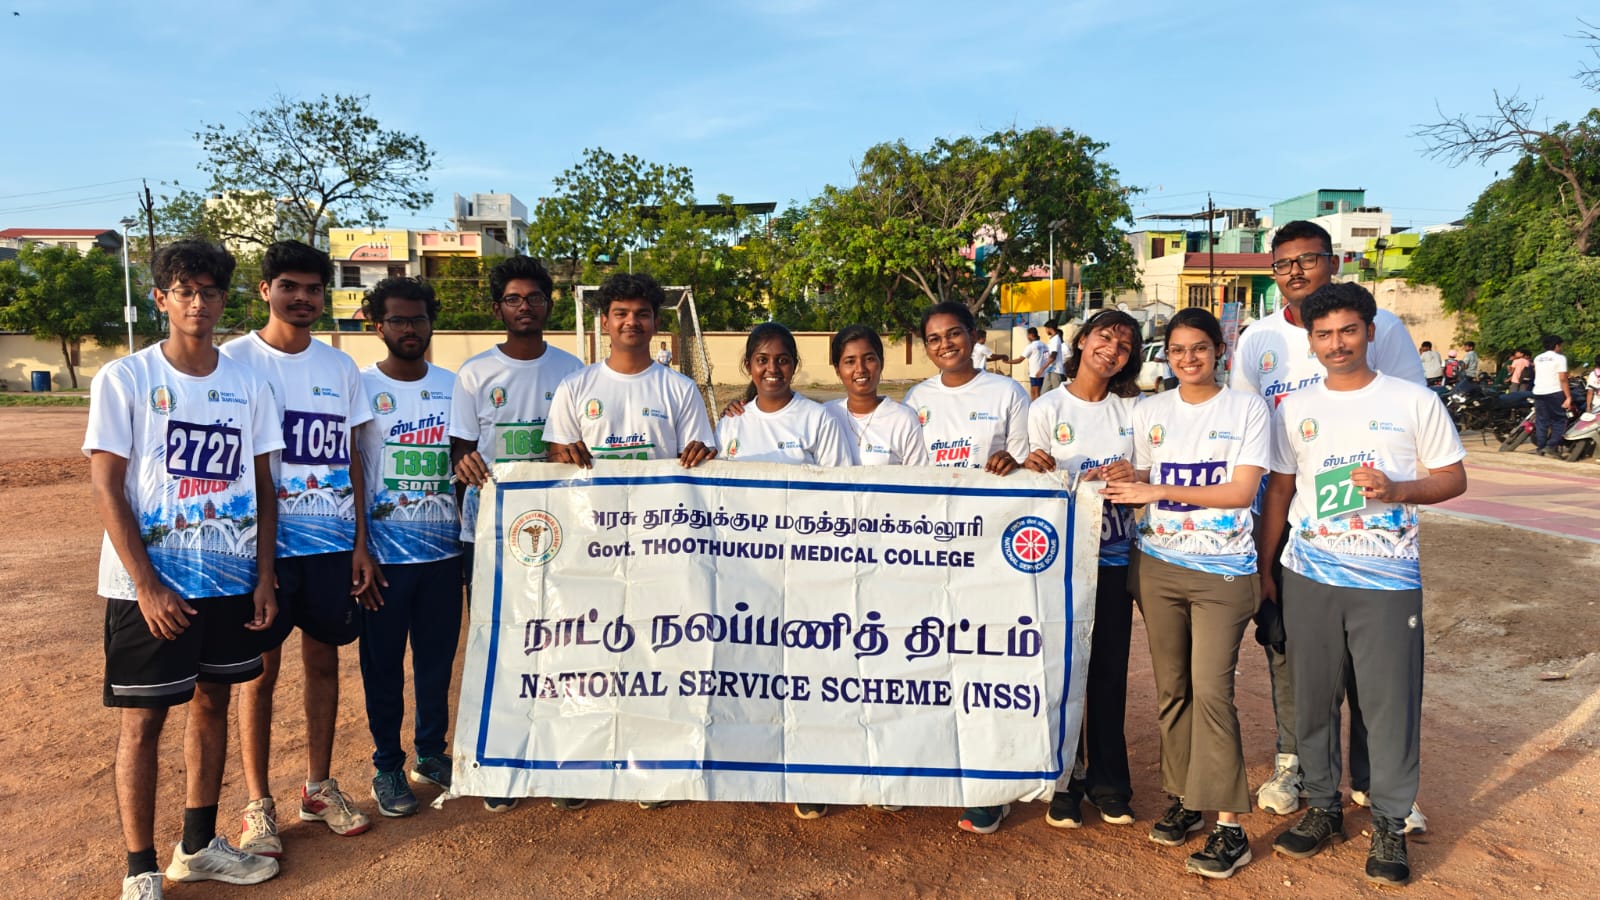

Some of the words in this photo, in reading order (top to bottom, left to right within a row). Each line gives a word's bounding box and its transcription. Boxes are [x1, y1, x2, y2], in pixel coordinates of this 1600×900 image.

[390, 411, 445, 436] ஸ்டார்ட்
[400, 425, 445, 445] RUN
[168, 428, 240, 475] 2727
[292, 418, 346, 459] 1057
[930, 436, 972, 450] ஸ்டார்ட்
[392, 450, 448, 476] 1339
[936, 447, 971, 462] RUN
[1323, 450, 1376, 467] ஸ்டார்ட்
[398, 481, 440, 491] SDAT
[643, 503, 768, 531] தூத்துக்குடி
[775, 511, 983, 542] மருத்துவக்கல்லூரி
[587, 541, 636, 558] Govt.
[642, 537, 784, 560] THOOTHUKUDI
[790, 544, 878, 563] MEDICAL
[884, 548, 975, 567] COLLEGE
[524, 608, 636, 656] நாட்டு
[651, 602, 889, 661] நலப்பணித்
[904, 615, 1044, 662] திட்டம்
[519, 671, 668, 698] NATIONAL
[678, 670, 811, 701] SERVICE
[821, 676, 952, 706] SCHEME
[963, 681, 1040, 718] (NSS)
